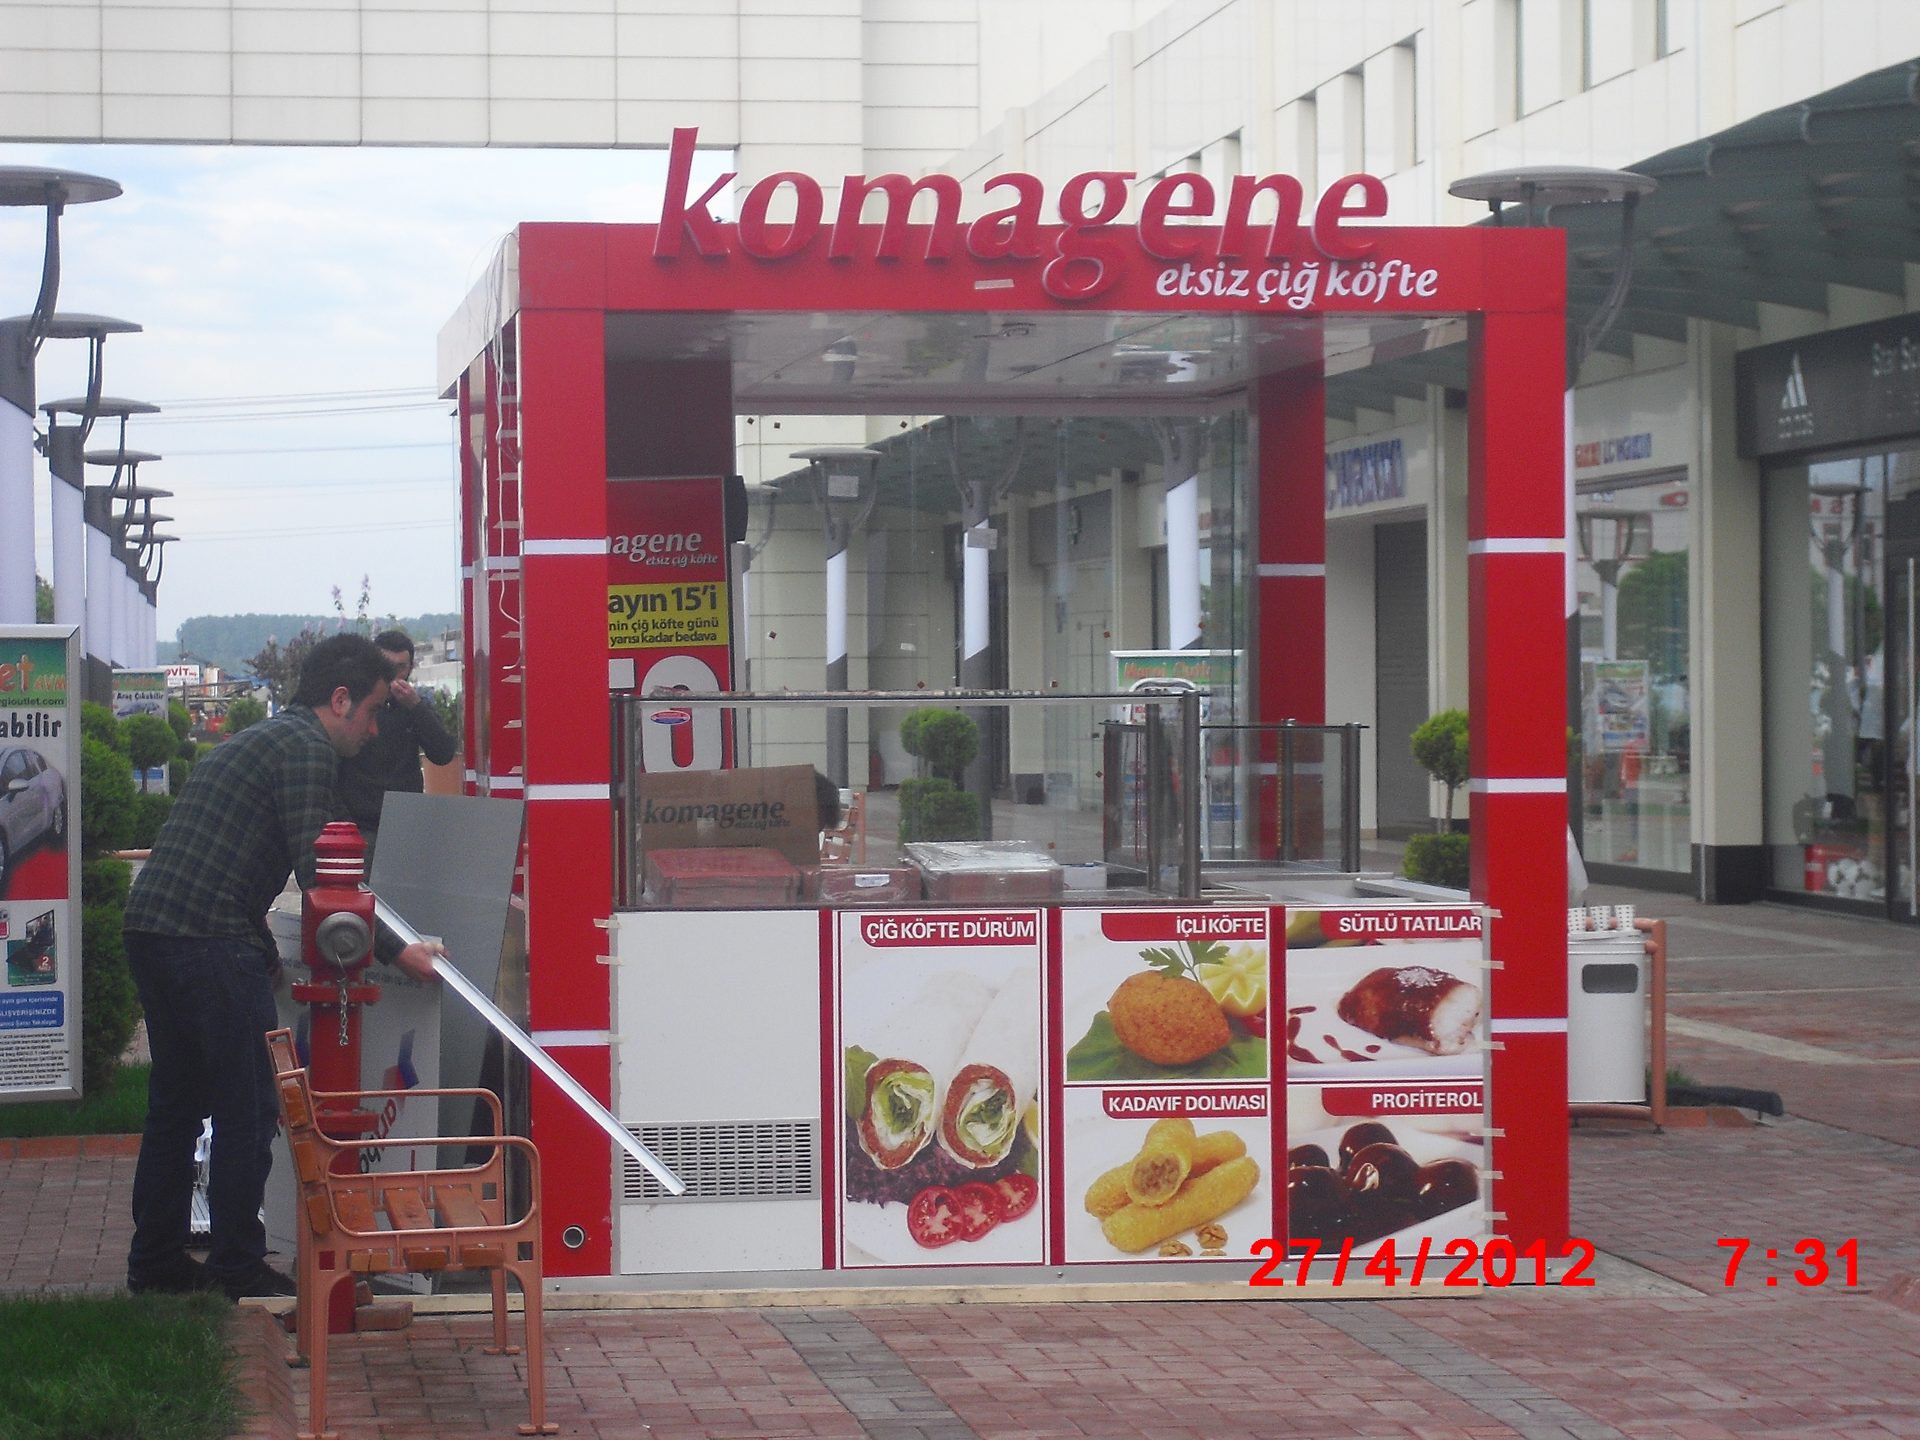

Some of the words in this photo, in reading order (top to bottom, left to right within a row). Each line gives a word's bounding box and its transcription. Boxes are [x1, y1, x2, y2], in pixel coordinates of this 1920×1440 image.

[651, 126, 1390, 301] komagene
[1156, 264, 1248, 297] etsiz
[1257, 262, 1318, 310] çiğ
[1325, 260, 1439, 300] köfte
[608, 593, 667, 620] ayın
[671, 585, 717, 612] 15'i
[631, 620, 649, 634] çiğ
[652, 617, 684, 630] köfte
[687, 616, 719, 631] günü
[641, 631, 674, 644] kadar
[675, 631, 717, 643] bedava
[644, 800, 785, 829] komagene
[866, 917, 898, 944] ÇİĞ
[901, 917, 959, 939] KÖFTE
[963, 916, 1034, 938] DÜRÜM
[1176, 914, 1206, 936] İÇLİ
[1208, 914, 1264, 934] KÖFTE
[1339, 912, 1397, 933] SÜTLÜ
[1401, 915, 1482, 932] TATLILAR
[1108, 1097, 1180, 1112] KADAYIF
[1185, 1095, 1266, 1111] DOLMASI
[1371, 1090, 1482, 1109] PROFİTEROL
